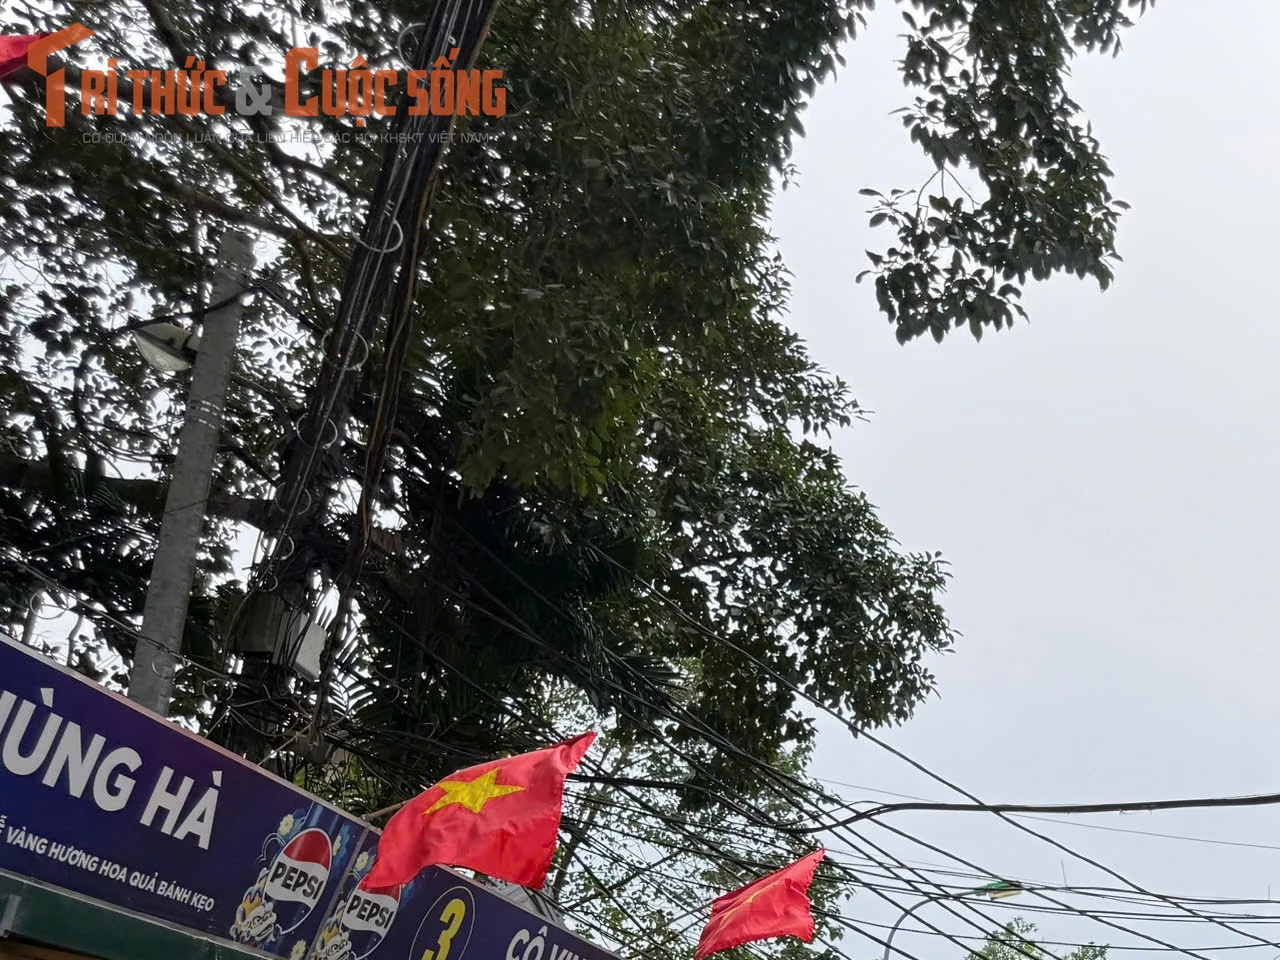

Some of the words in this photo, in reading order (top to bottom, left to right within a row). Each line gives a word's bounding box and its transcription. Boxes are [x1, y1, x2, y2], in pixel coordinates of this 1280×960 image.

[140, 766, 223, 851] HÀ
[6, 826, 48, 854] VÀNG
[48, 842, 100, 872] HƯƠNG
[99, 860, 128, 883] HOA
[129, 872, 159, 893] QUẢ
[156, 880, 195, 906] BÁNH
[190, 894, 215, 912] KẸO
[269, 861, 325, 901] PEPSI
[346, 894, 394, 929] PEPSI
